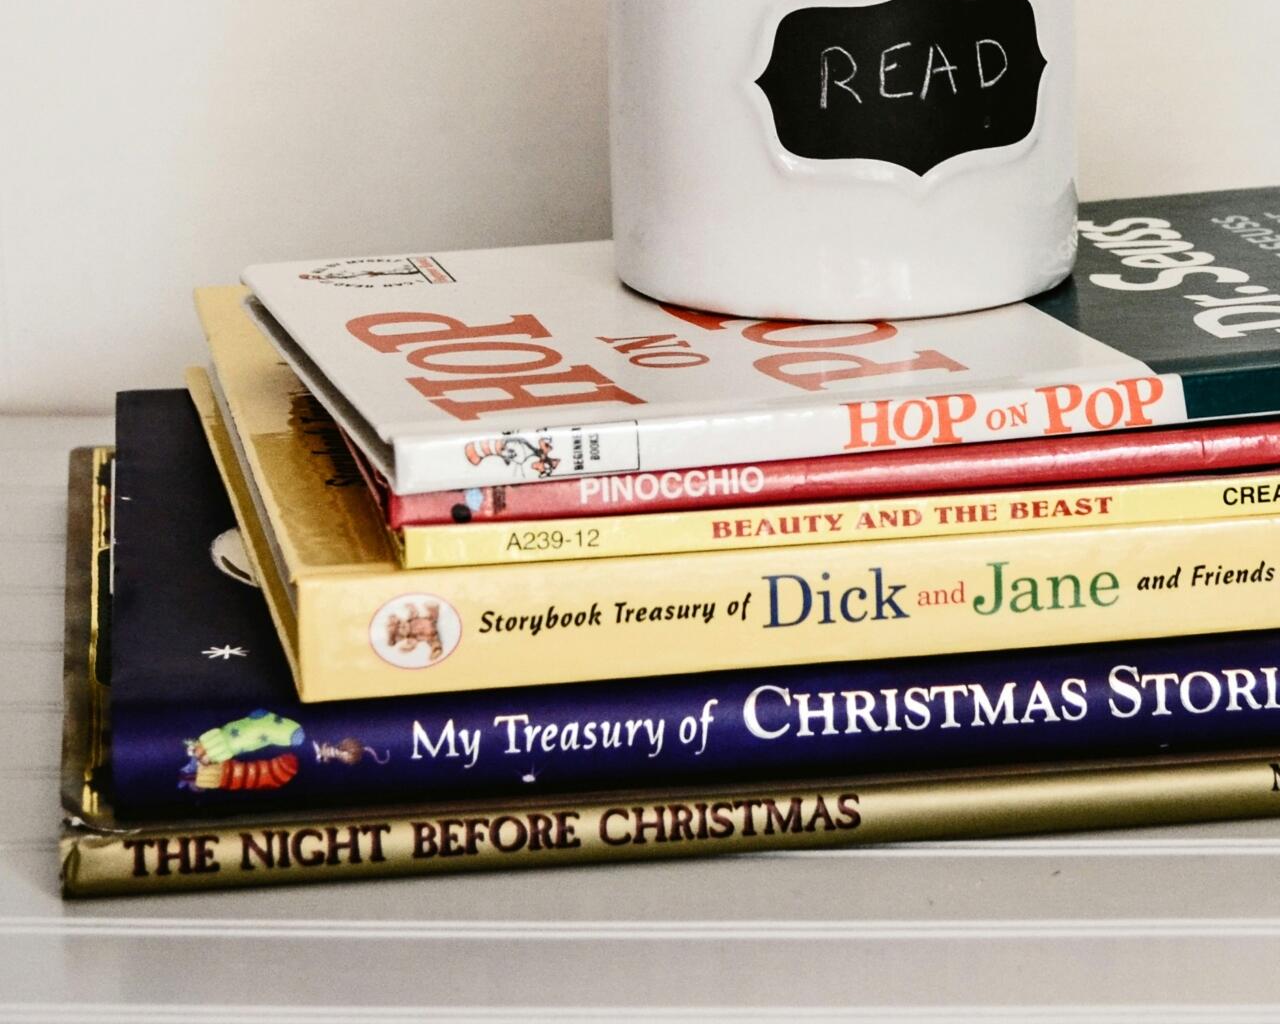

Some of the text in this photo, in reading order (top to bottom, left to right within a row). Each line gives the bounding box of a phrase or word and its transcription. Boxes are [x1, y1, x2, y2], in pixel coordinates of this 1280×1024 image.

[819, 38, 1008, 109] READ
[1078, 217, 1250, 291] Seuss
[345, 311, 648, 421] HOP
[595, 333, 710, 368] ON
[840, 376, 1164, 450] HOP ON POP
[580, 467, 764, 503] PINOCCHIO
[711, 496, 1114, 540] BEAUTY AND THE BEAST
[506, 528, 600, 553] A239-12
[479, 560, 1276, 636] Storybook Treasury of Dick and Jane and Friends
[411, 719, 481, 769] My
[494, 711, 666, 758] Treasury
[679, 699, 716, 754] of
[742, 678, 1089, 740] CHRISTMAS
[124, 794, 862, 878] THE NIGHT BEFORE CHRISTMAS
